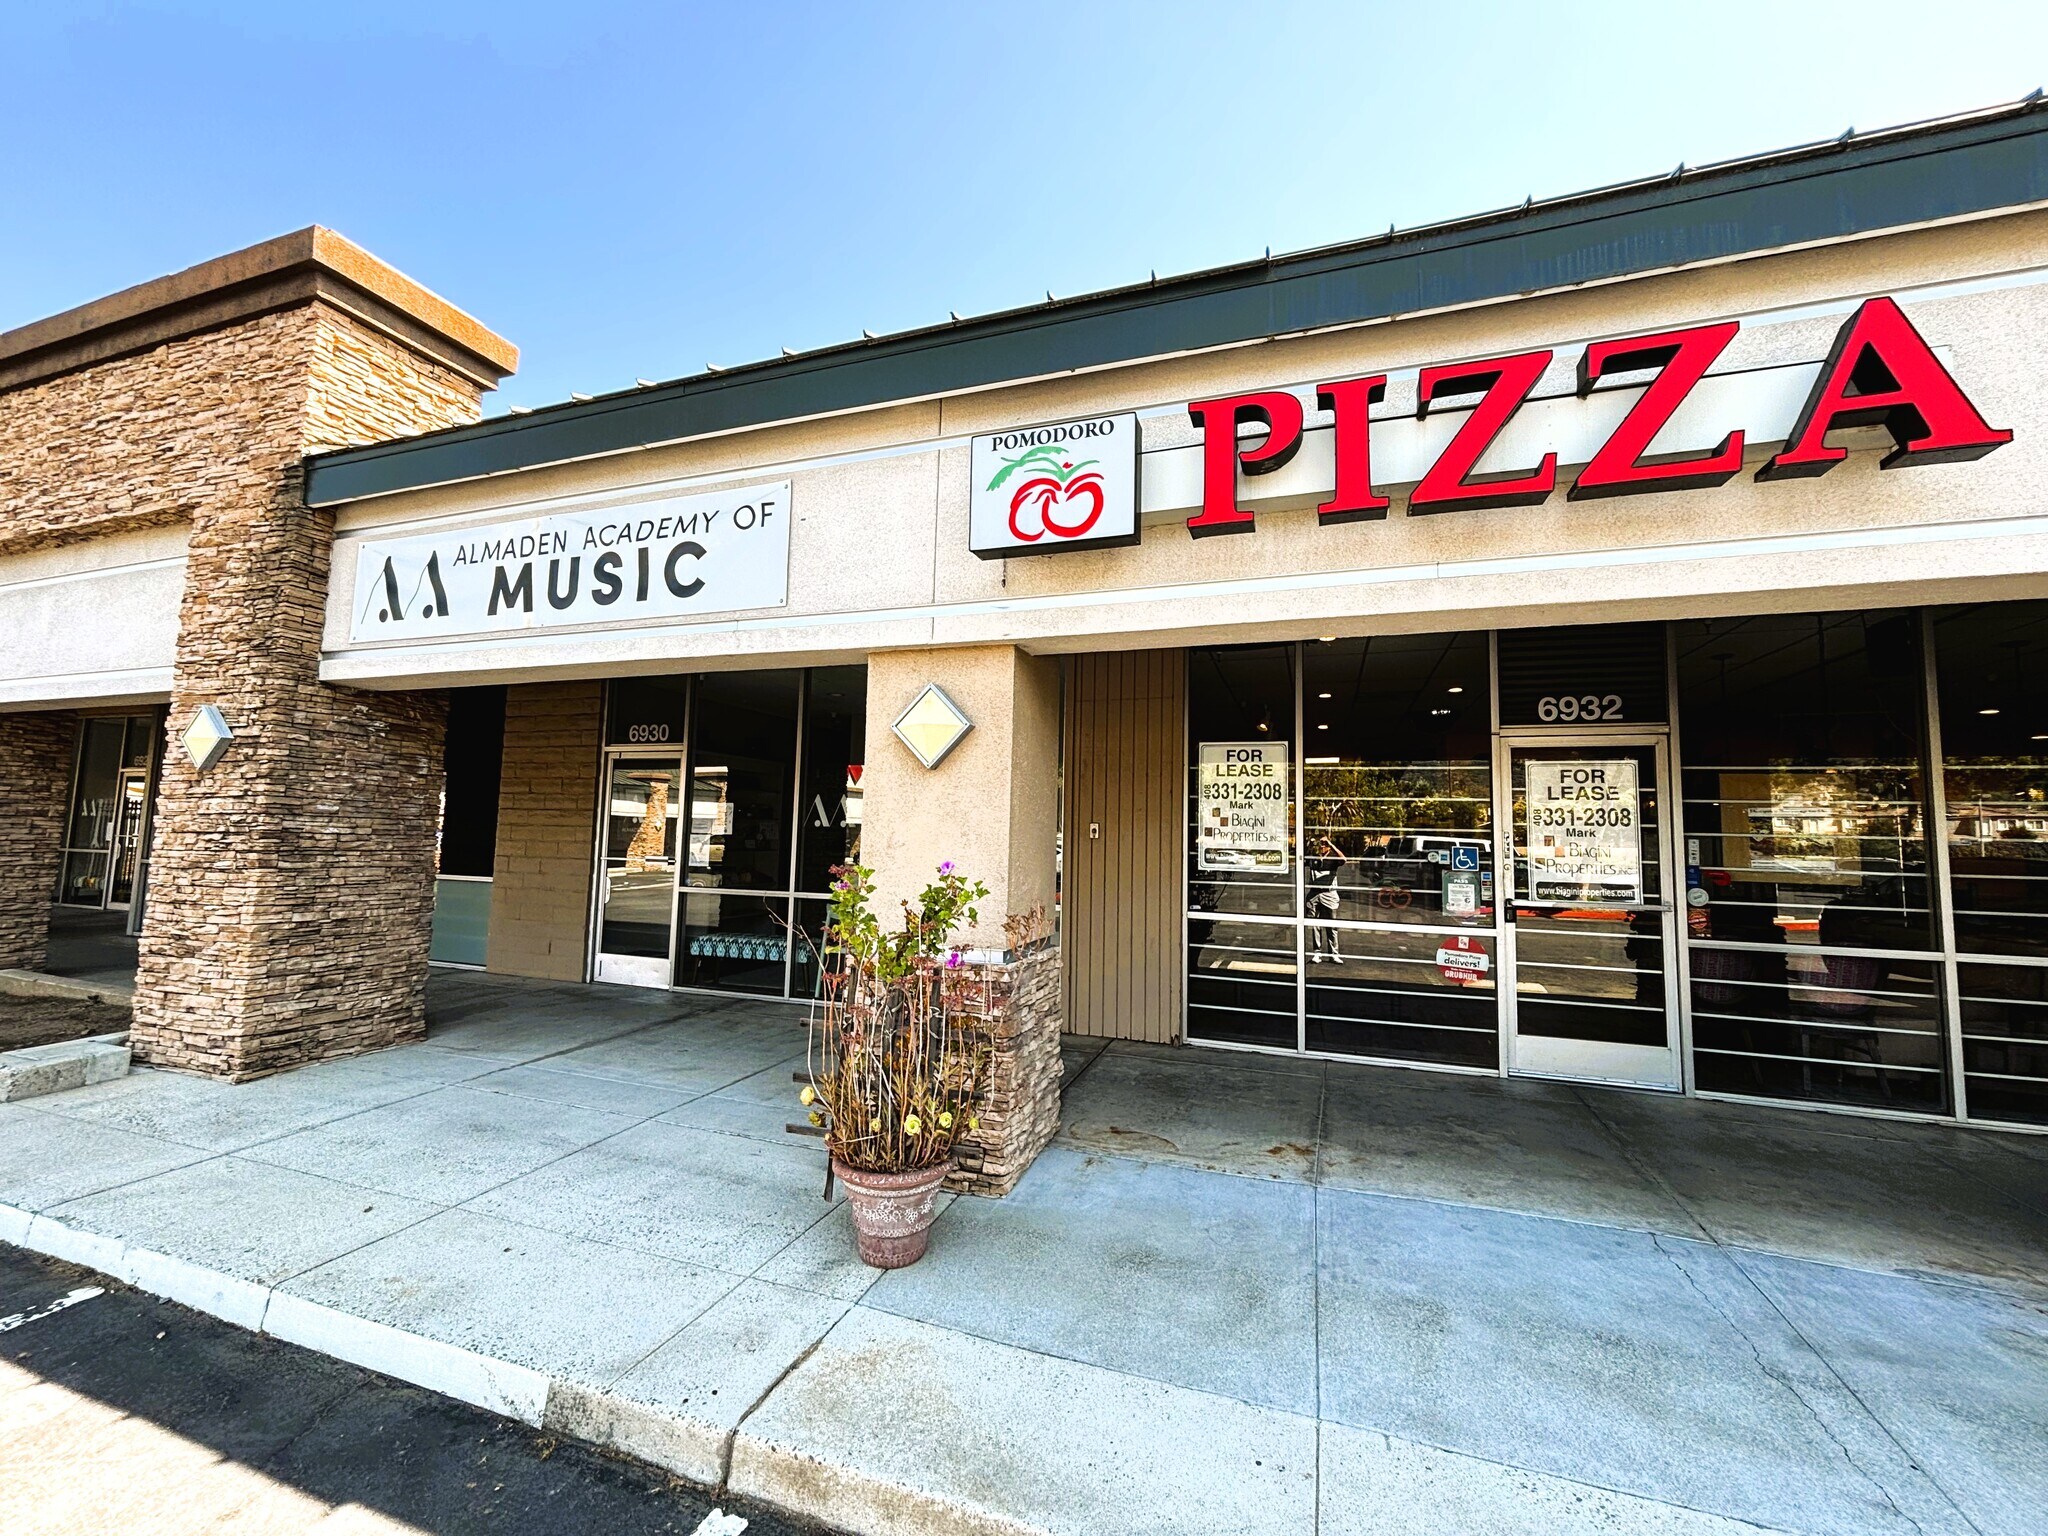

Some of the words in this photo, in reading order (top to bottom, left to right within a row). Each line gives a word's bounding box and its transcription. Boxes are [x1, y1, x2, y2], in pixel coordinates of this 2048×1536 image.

[1187, 296, 2014, 528] PIZZA
[992, 420, 1115, 451] POMODORO
[453, 530, 567, 566] ALMADEN
[583, 510, 719, 550] ACADEMY
[733, 502, 775, 530] OF
[487, 541, 707, 616] MUSIC
[1538, 695, 1623, 721] 6932
[629, 724, 669, 742] 6930
[1226, 749, 1263, 762] FOR
[1216, 764, 1273, 777] LEASE
[1560, 769, 1605, 783] FOR
[1212, 783, 1282, 800] 331-2308
[1547, 786, 1619, 801] LEASE
[1229, 801, 1254, 810] Mark
[1533, 809, 1542, 826] 408
[1543, 807, 1632, 827] 331-2308
[1566, 828, 1597, 838] Mark
[1538, 886, 1634, 898] www.biaginiproperties.com
[1444, 957, 1480, 968] delivers!
[1444, 970, 1477, 981] GRUBHUB
